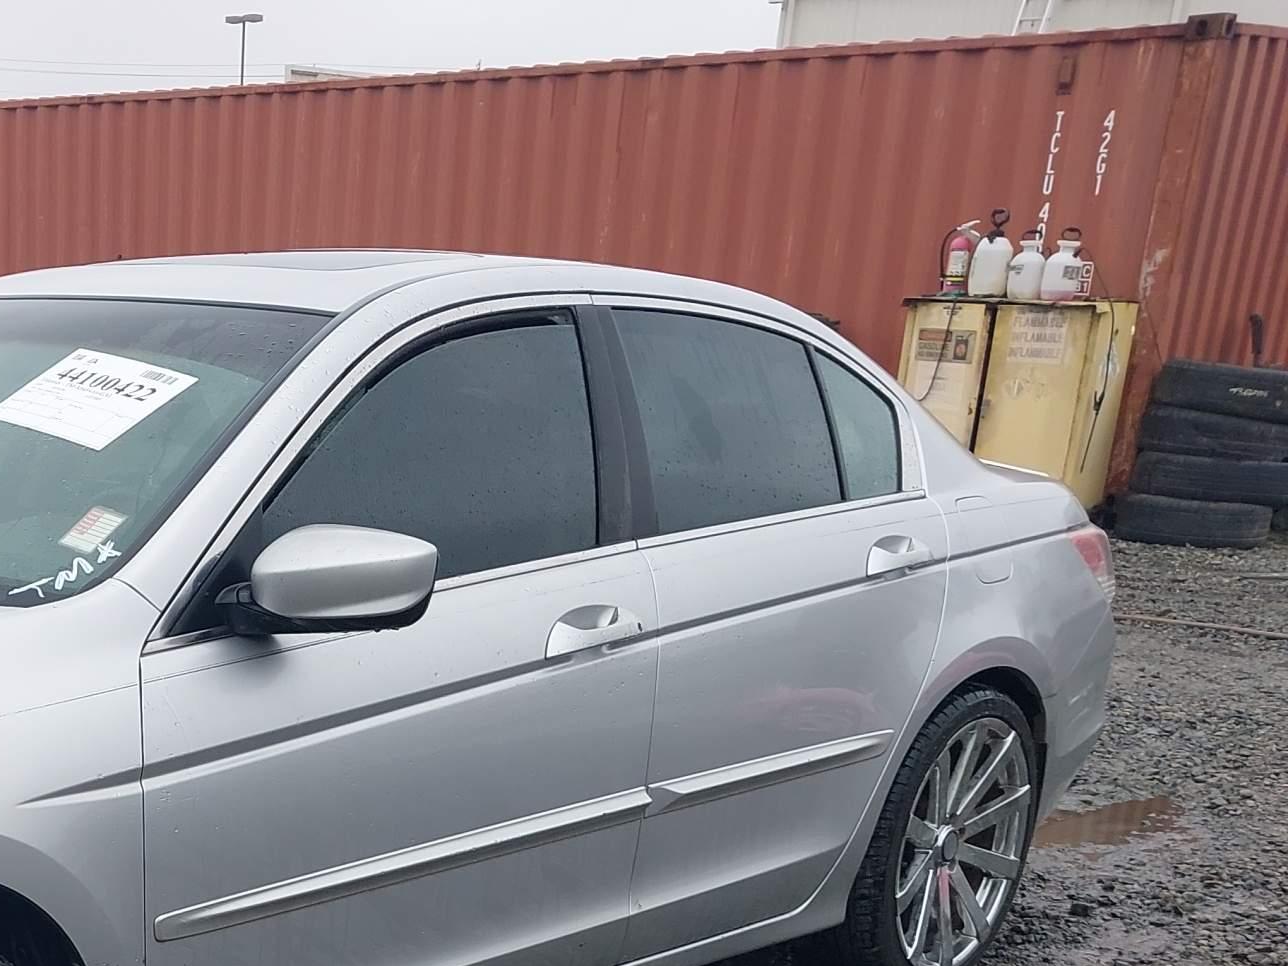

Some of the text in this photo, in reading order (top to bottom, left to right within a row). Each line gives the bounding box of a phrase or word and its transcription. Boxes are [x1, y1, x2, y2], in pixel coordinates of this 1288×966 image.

[1042, 111, 1064, 195] TCLU
[1096, 110, 1115, 196] 42G1
[56, 367, 157, 402] 44100422
